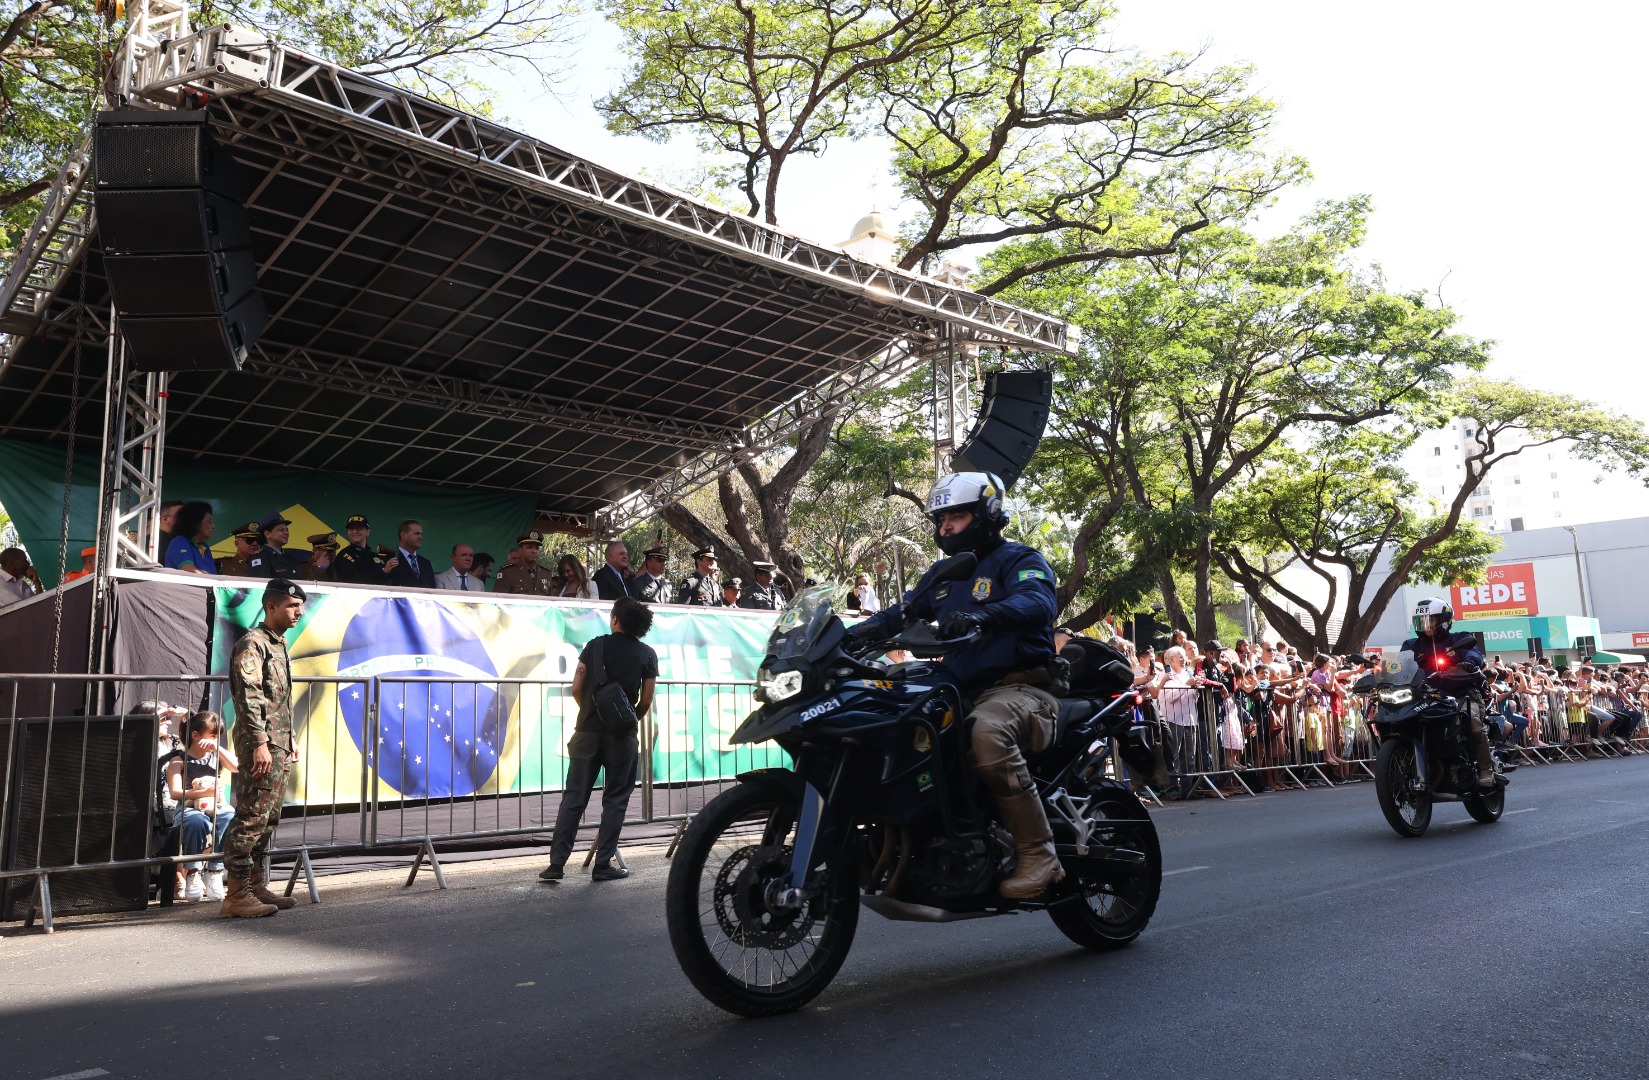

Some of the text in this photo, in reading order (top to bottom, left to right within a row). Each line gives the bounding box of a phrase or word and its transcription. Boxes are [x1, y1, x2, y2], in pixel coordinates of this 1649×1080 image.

[929, 493, 952, 509] PRF
[1484, 569, 1505, 579] JAS
[1460, 581, 1527, 606] REDE
[1415, 607, 1430, 615] PRF
[860, 678, 895, 690] PRF
[800, 698, 842, 722] 20021
